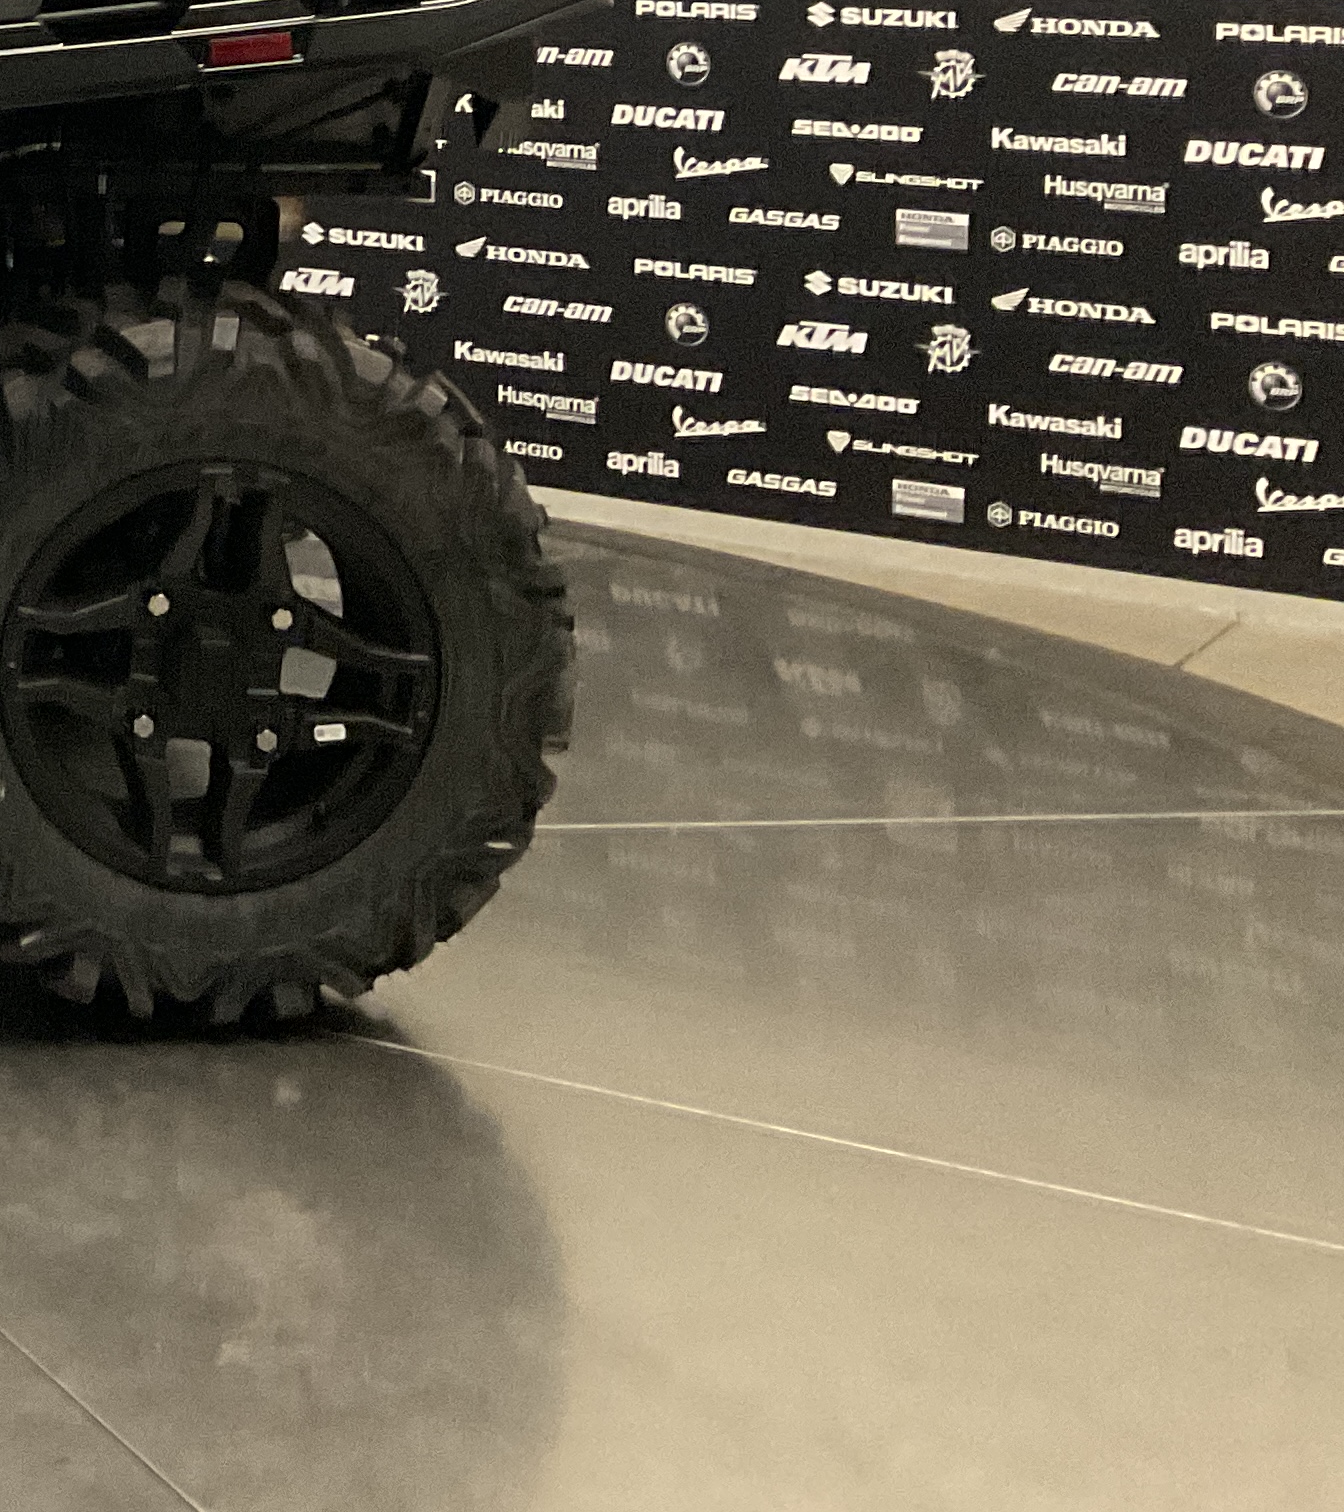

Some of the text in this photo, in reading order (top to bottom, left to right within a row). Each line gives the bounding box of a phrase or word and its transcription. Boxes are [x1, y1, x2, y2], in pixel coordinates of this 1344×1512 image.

[636, 0, 760, 20] POLARIS
[840, 6, 959, 30] SUZUKI
[1030, 17, 1160, 38] HONDA
[1216, 22, 1344, 45] POLARI
[537, 47, 614, 66] n-am
[779, 54, 871, 84] KTM
[1051, 73, 1188, 97] can-am
[611, 104, 725, 132] DUCATI
[991, 127, 1126, 156] Kawasaki
[1184, 140, 1325, 171] DUCATI
[673, 146, 769, 179] Vespa
[855, 170, 984, 190] SLINGSHOT
[1044, 174, 1167, 202] Husqvarna
[480, 188, 563, 208] PIAGGIO
[608, 194, 681, 220] aprilia
[1260, 187, 1344, 223] Vesp
[729, 207, 841, 230] GASGAS
[328, 227, 425, 251] SUZUKI
[1022, 233, 1124, 256] PIAGGIO
[487, 245, 590, 269] HONDA
[1179, 240, 1269, 270] aprilia
[279, 267, 355, 297] KTM
[634, 258, 758, 285] POLARIS
[837, 277, 955, 305] SUZUKI
[503, 296, 613, 322] can-am
[1028, 297, 1156, 324] HONDA
[776, 321, 868, 354] KTM
[454, 340, 564, 372] Kawasaki
[1048, 354, 1184, 384] can-am
[610, 361, 723, 393] DUCATI
[498, 385, 598, 414] Husqvarna
[672, 406, 767, 437] Vespa
[988, 404, 1122, 439] Kawasaki
[505, 440, 563, 460] AGGIO
[852, 439, 979, 466] SLINGSHOT
[1179, 426, 1319, 462] DUCATI
[607, 451, 679, 478] aprilia
[1041, 453, 1162, 485] Husqvarna
[727, 469, 837, 496] GASGAS
[1019, 510, 1119, 538] PIAGGIO
[1174, 528, 1264, 558] aprilia
